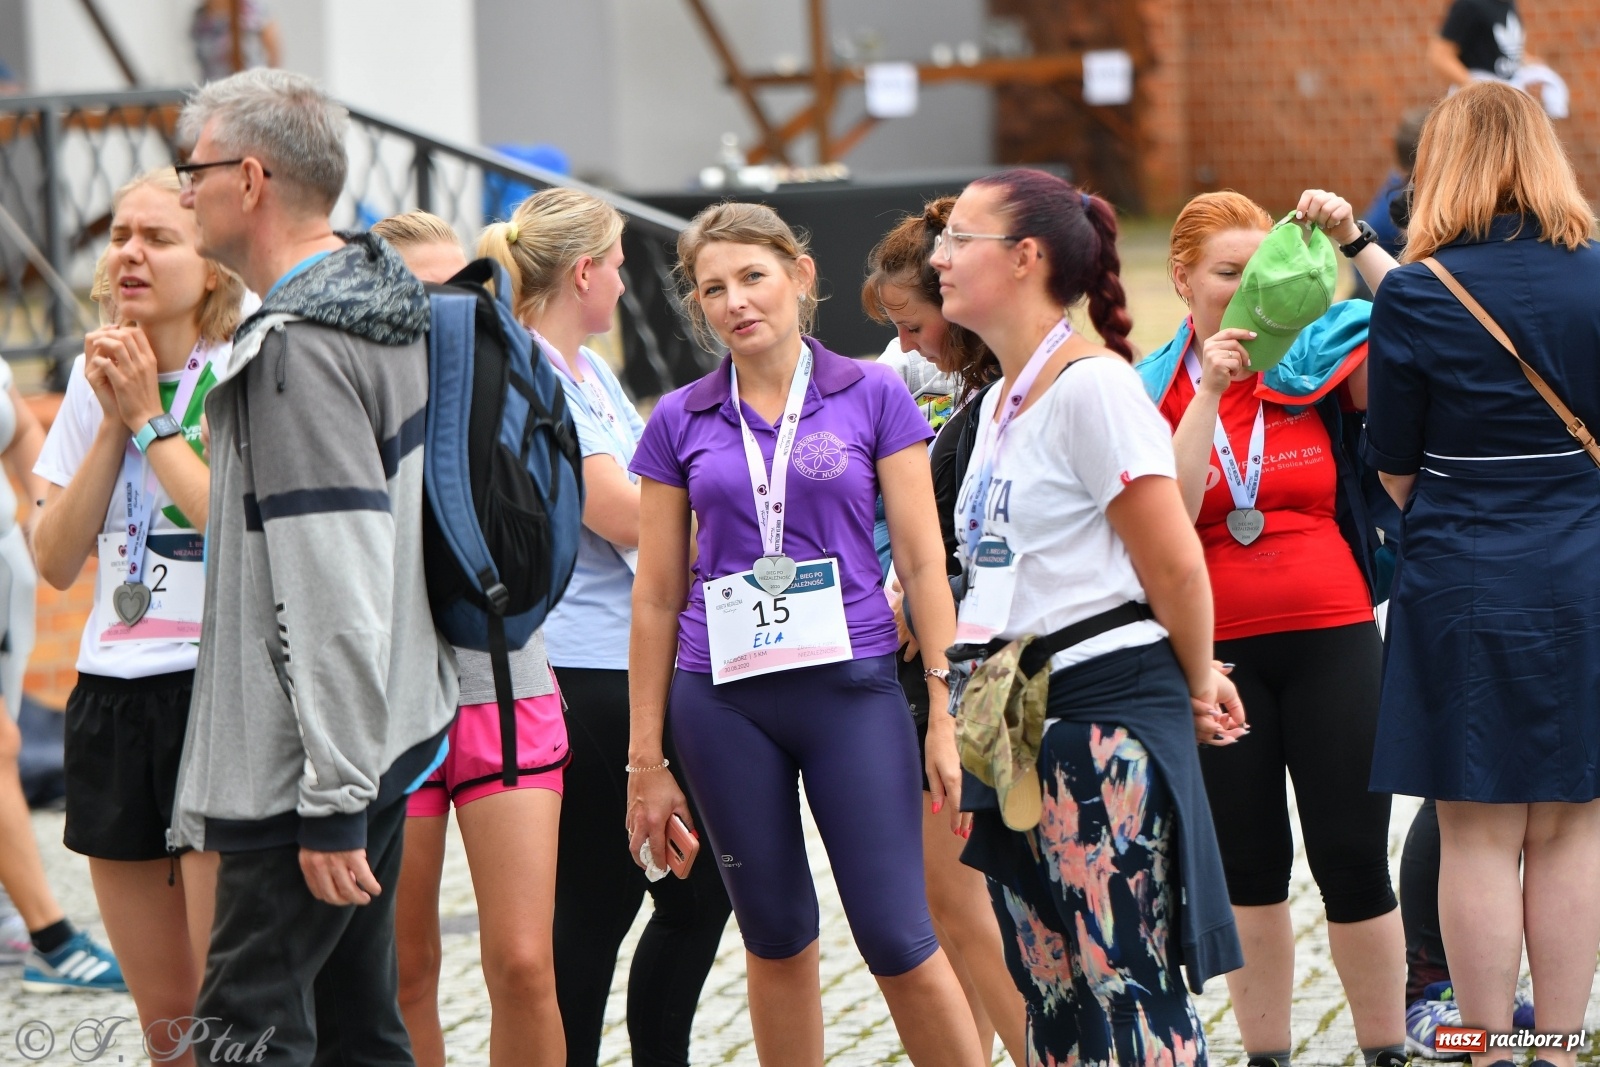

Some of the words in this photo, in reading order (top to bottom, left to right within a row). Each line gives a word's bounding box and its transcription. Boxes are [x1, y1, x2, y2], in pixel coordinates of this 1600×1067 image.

[1301, 445, 1322, 457] 2016
[794, 457, 817, 478] QUALITY
[822, 454, 848, 479] NUTRITION
[151, 564, 168, 592] 2
[789, 578, 824, 589] ZALEŻNOŚĆ
[800, 572, 814, 580] BIEG
[752, 596, 790, 628] 15
[753, 632, 784, 648] ELA
